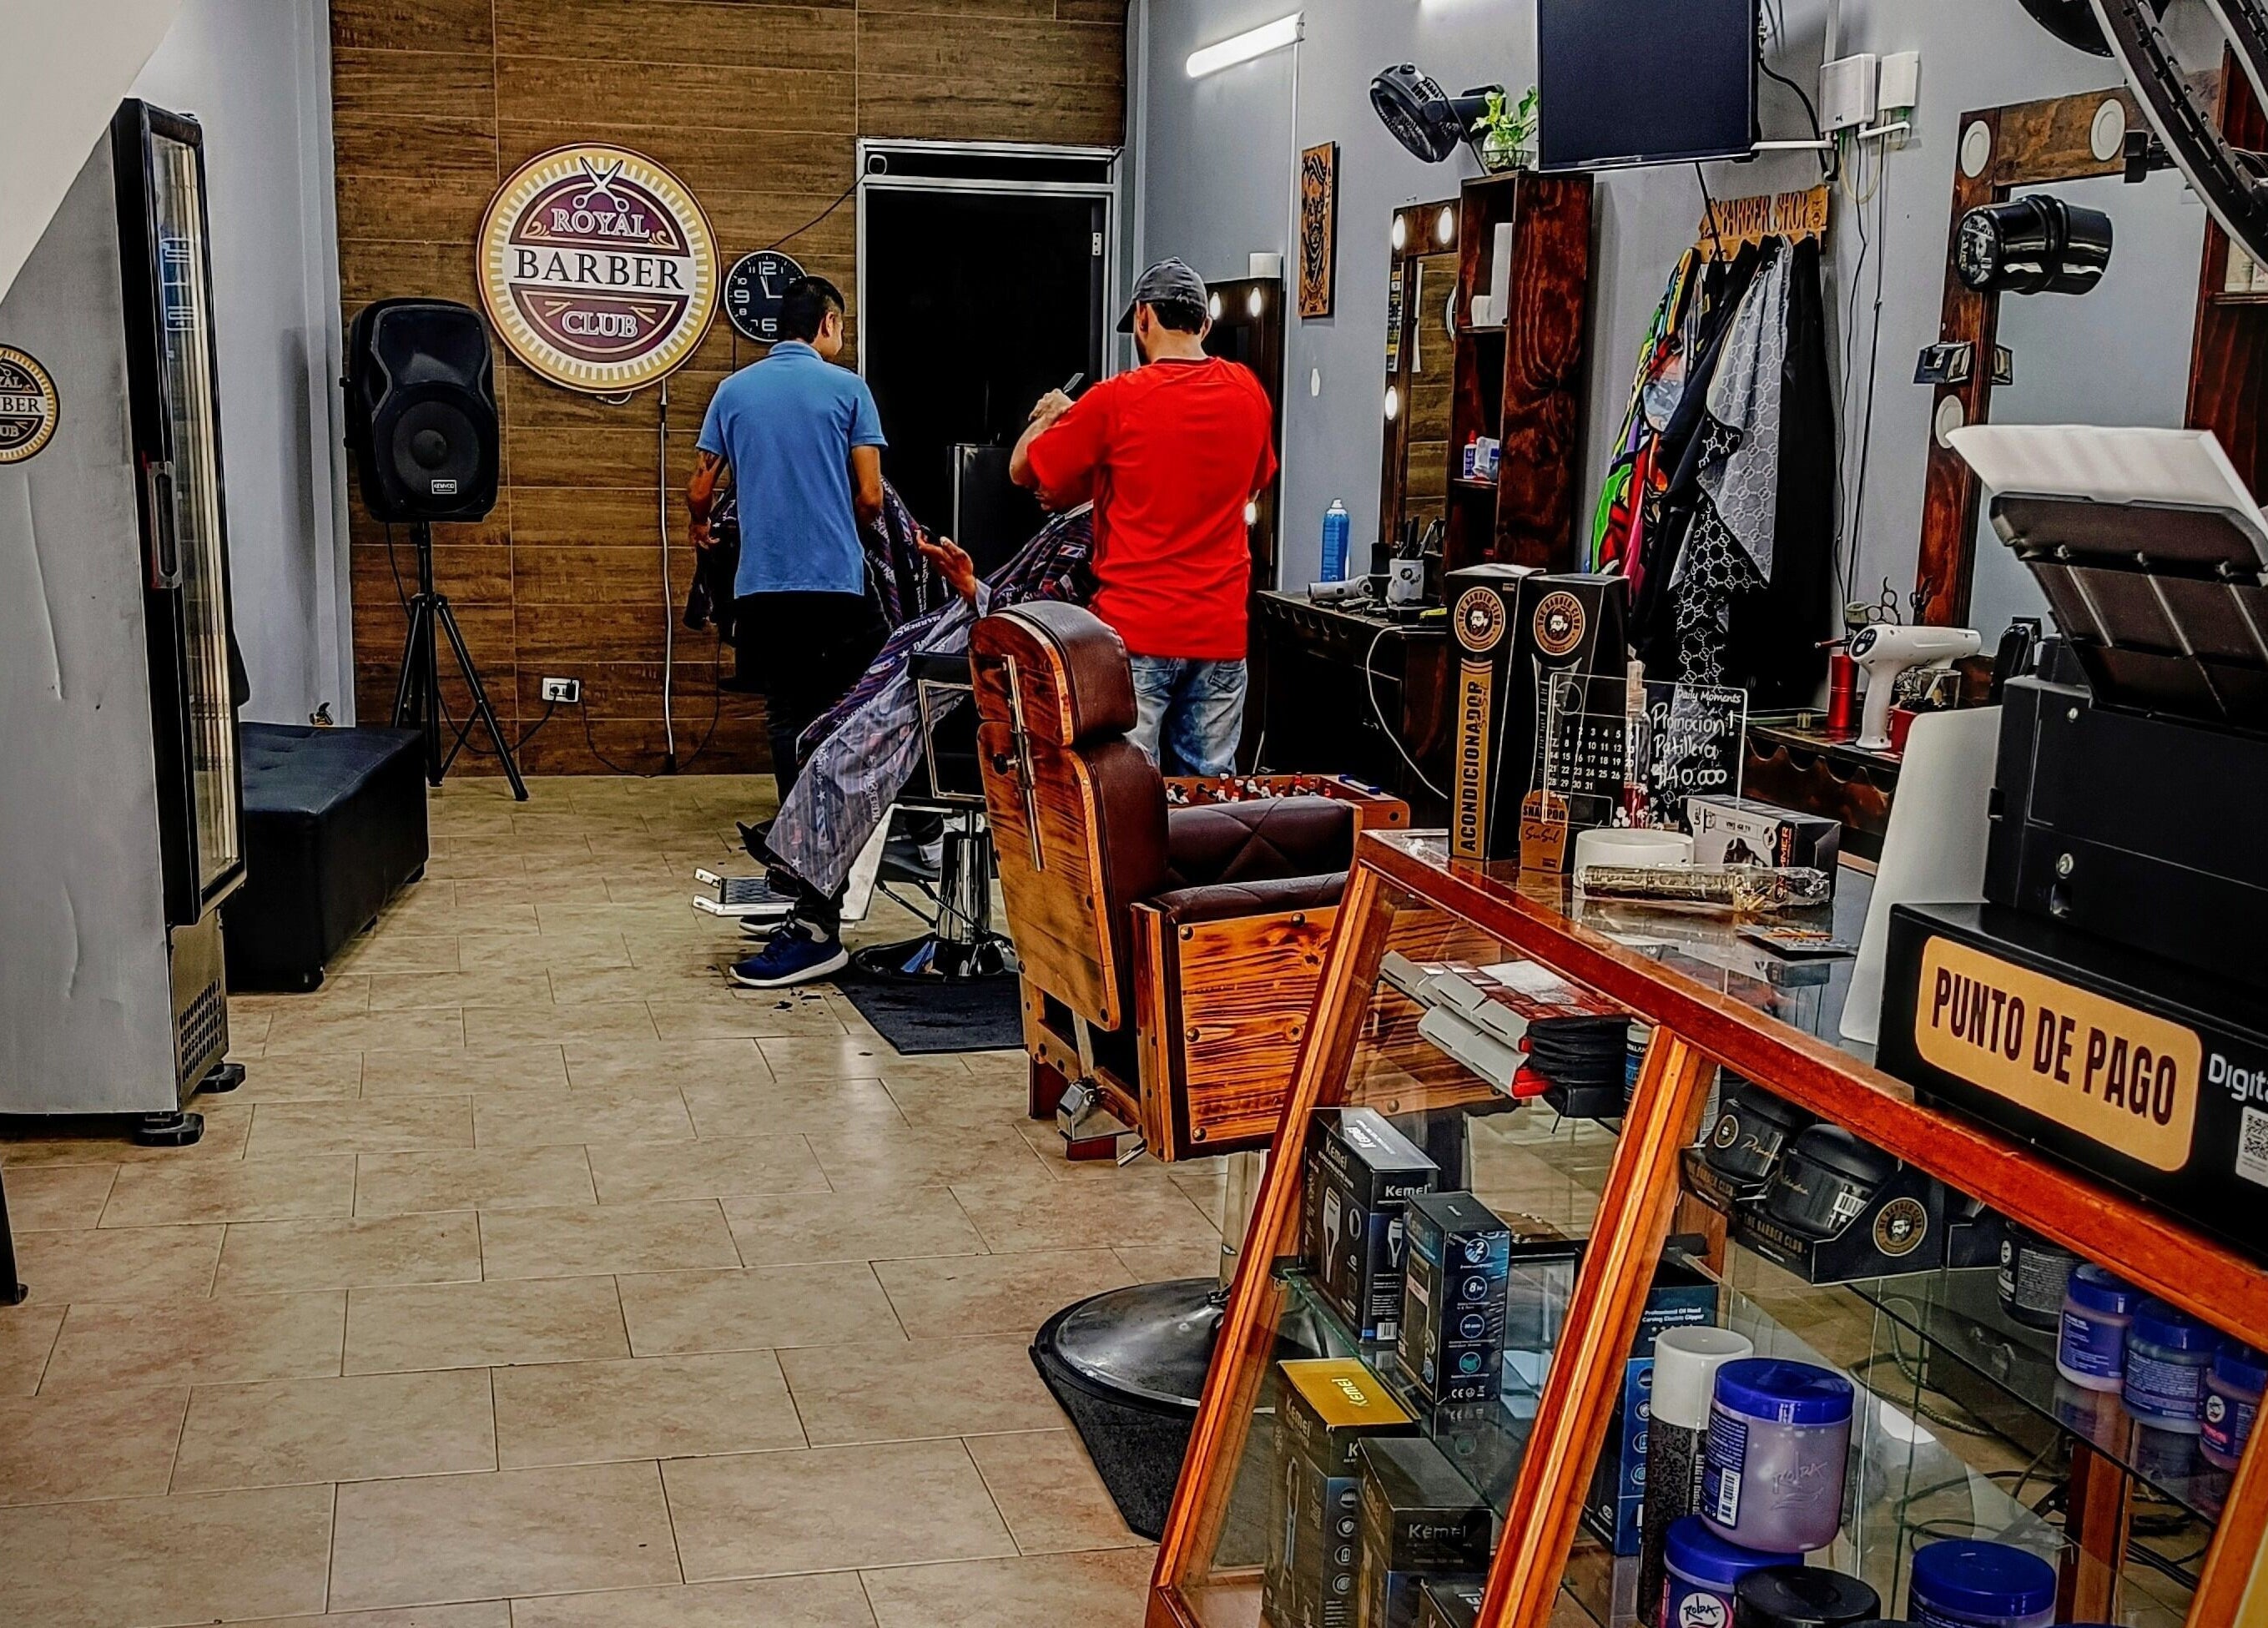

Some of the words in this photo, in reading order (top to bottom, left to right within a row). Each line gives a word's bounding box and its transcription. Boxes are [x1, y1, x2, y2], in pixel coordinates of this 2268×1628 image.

[1719, 194, 1771, 236] BARBER
[551, 207, 651, 239] ROYAL
[513, 249, 684, 290] BARBER
[759, 261, 777, 275] 12
[733, 289, 750, 304] 9
[561, 310, 638, 338] CLUB
[761, 318, 778, 332] 6
[1676, 687, 1698, 703] Daily
[1701, 691, 1741, 703] Moments
[1590, 728, 1596, 736] 3
[1603, 729, 1609, 738] 4
[1615, 730, 1621, 738] 5
[1565, 739, 1570, 748] 8
[1588, 742, 1596, 750] 10
[1600, 743, 1609, 751] 11
[1614, 744, 1622, 753] 12
[1460, 680, 1484, 853] ACONDICIONADOR
[1587, 755, 1595, 764] 17
[1612, 758, 1621, 766] 19
[1561, 766, 1570, 774] 22
[1585, 769, 1595, 777] 24
[1598, 770, 1607, 779] 25
[1611, 771, 1620, 779] 26
[1585, 782, 1593, 790] 31
[1523, 805, 1565, 820] SHAPOO
[1932, 966, 2025, 1061] PUNTO
[2033, 1006, 2075, 1085] DE
[2083, 1026, 2176, 1126] PAGO
[1475, 1241, 1484, 1254] 2
[1469, 1282, 1477, 1293] 8
